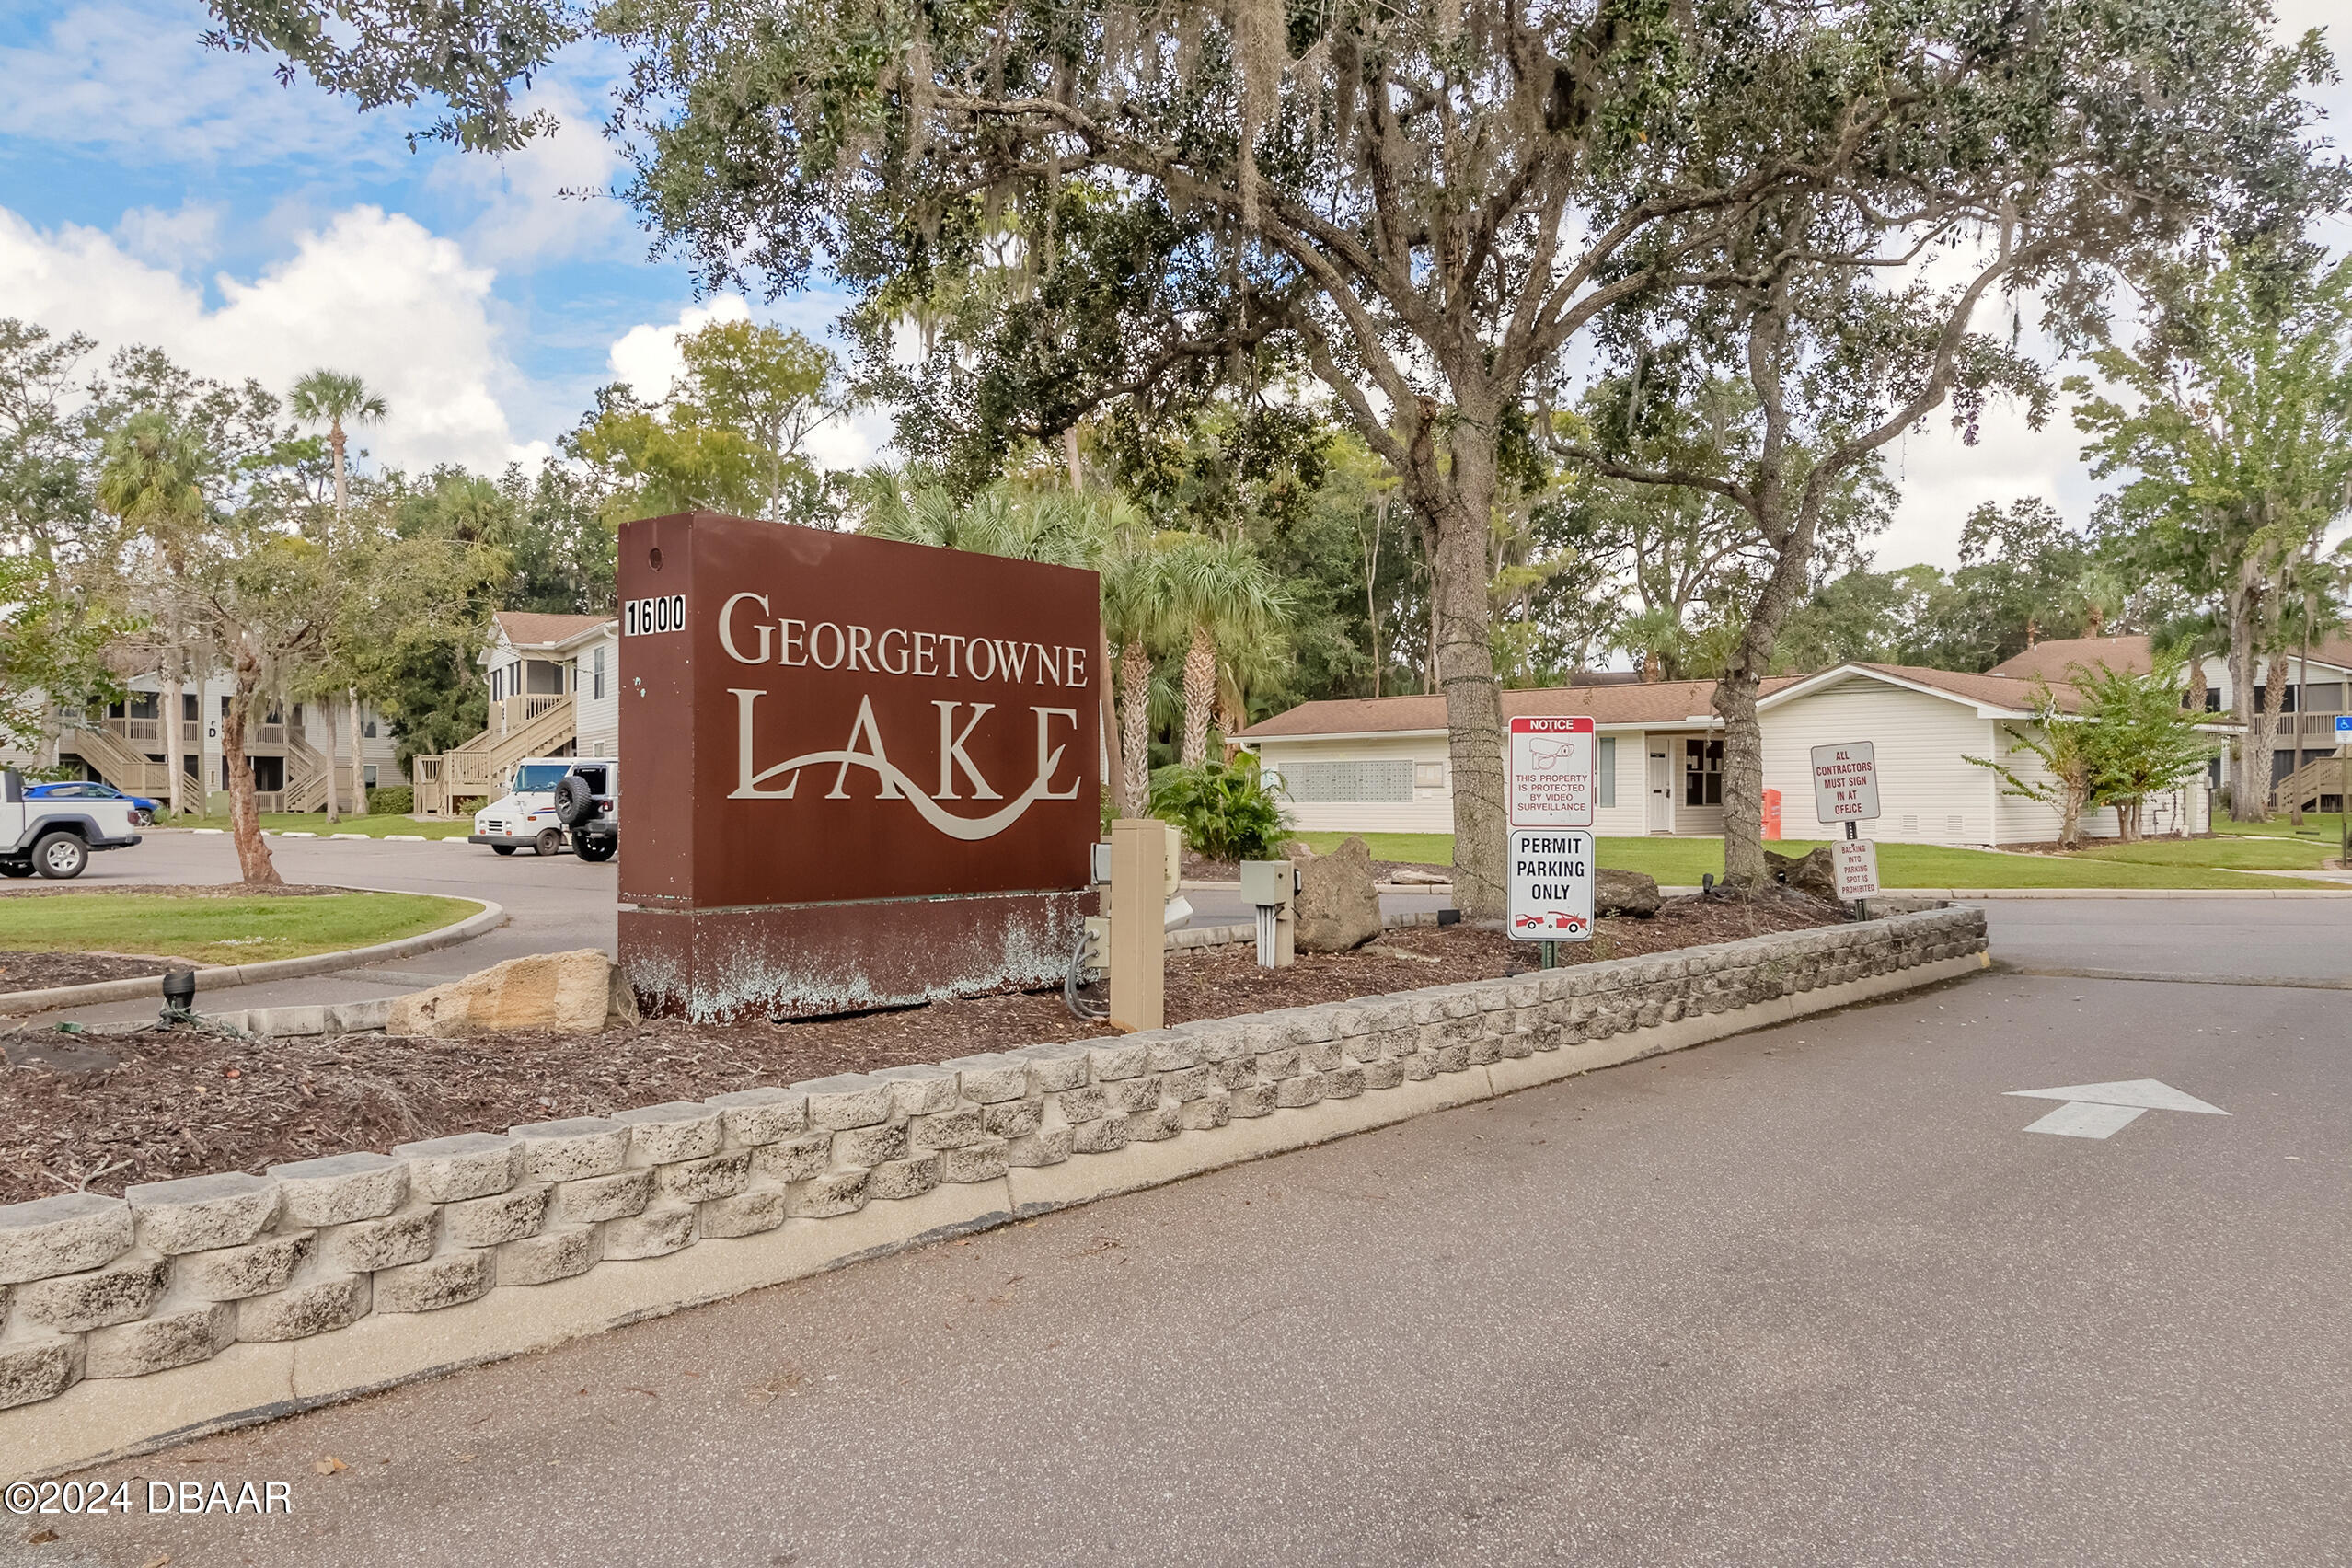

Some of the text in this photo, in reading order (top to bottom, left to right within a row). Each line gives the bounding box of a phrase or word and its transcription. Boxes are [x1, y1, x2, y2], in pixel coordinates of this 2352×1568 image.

[628, 595, 684, 634] 1600
[718, 592, 1089, 688] GEORGETOWNE
[1529, 720, 1574, 730] NOTICE
[1836, 751, 1850, 760] ALL
[727, 687, 1081, 841] LAKE
[1816, 762, 1872, 776] CONTRACTORS
[1825, 776, 1867, 789] MUST SIGN
[1837, 790, 1857, 801] IN AT
[1521, 838, 1582, 854] PERMIT
[1841, 845, 1866, 854] BACKING
[1517, 861, 1585, 877] PARKING
[1844, 865, 1868, 873] PARKING
[1531, 884, 1570, 900] ONLY
[1842, 884, 1874, 894] PROHIBITED
